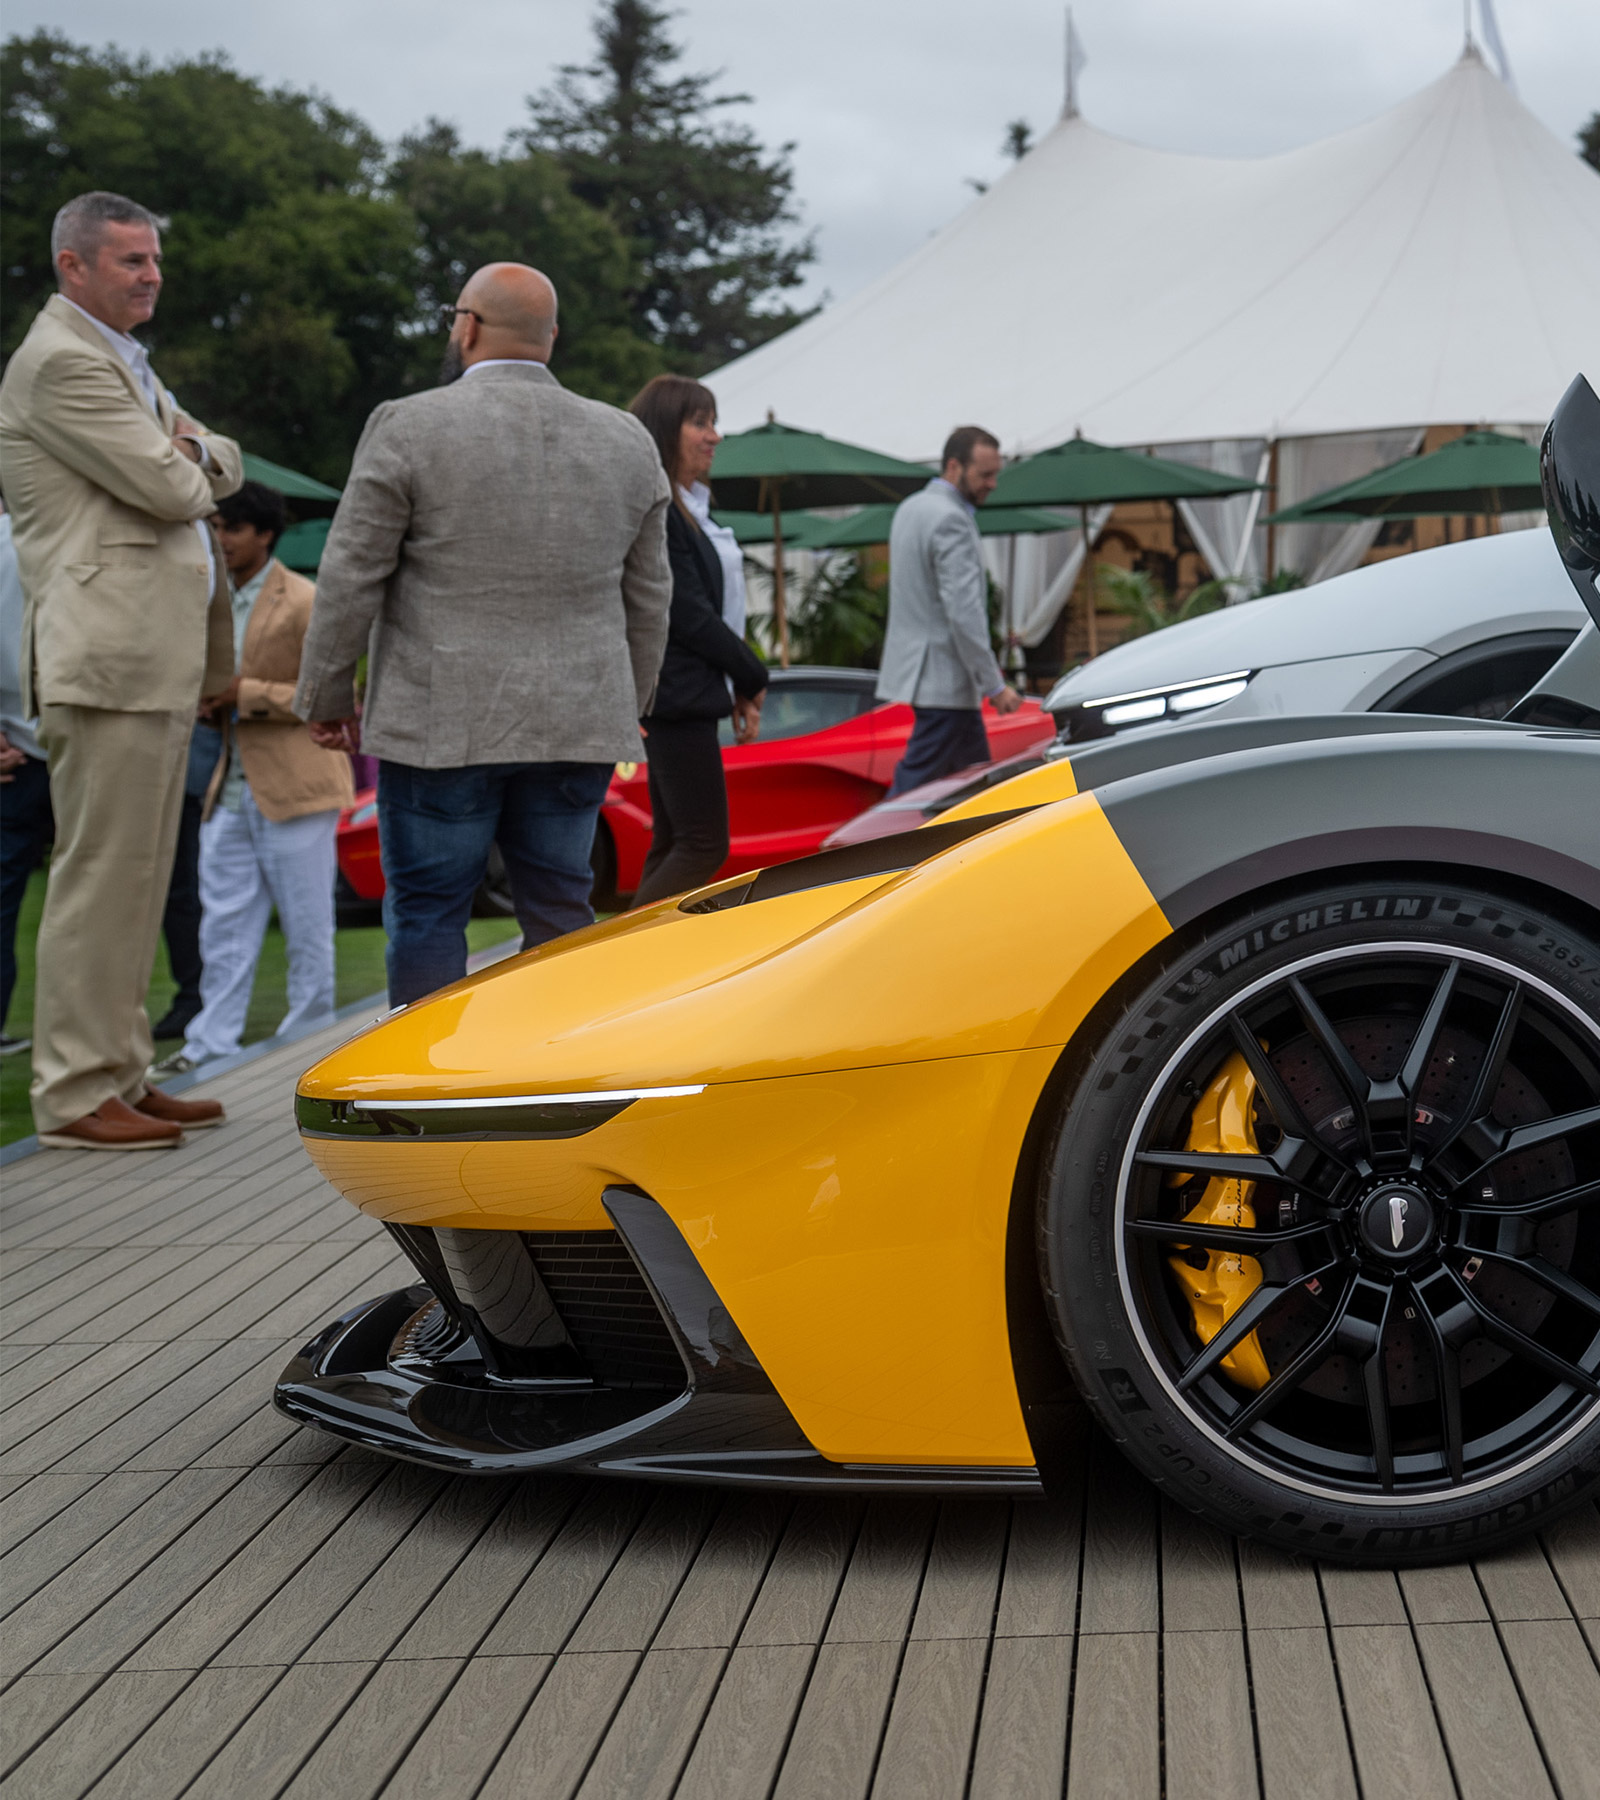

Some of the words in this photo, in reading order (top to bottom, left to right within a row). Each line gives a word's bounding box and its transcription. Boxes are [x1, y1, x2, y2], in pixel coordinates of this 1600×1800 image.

[1217, 898, 1421, 970] MICHELIN
[1109, 1377, 1137, 1406] R
[1141, 1420, 1164, 1444] 2
[1155, 1436, 1213, 1491] CUP
[1377, 1473, 1577, 1547] MICHELIN
